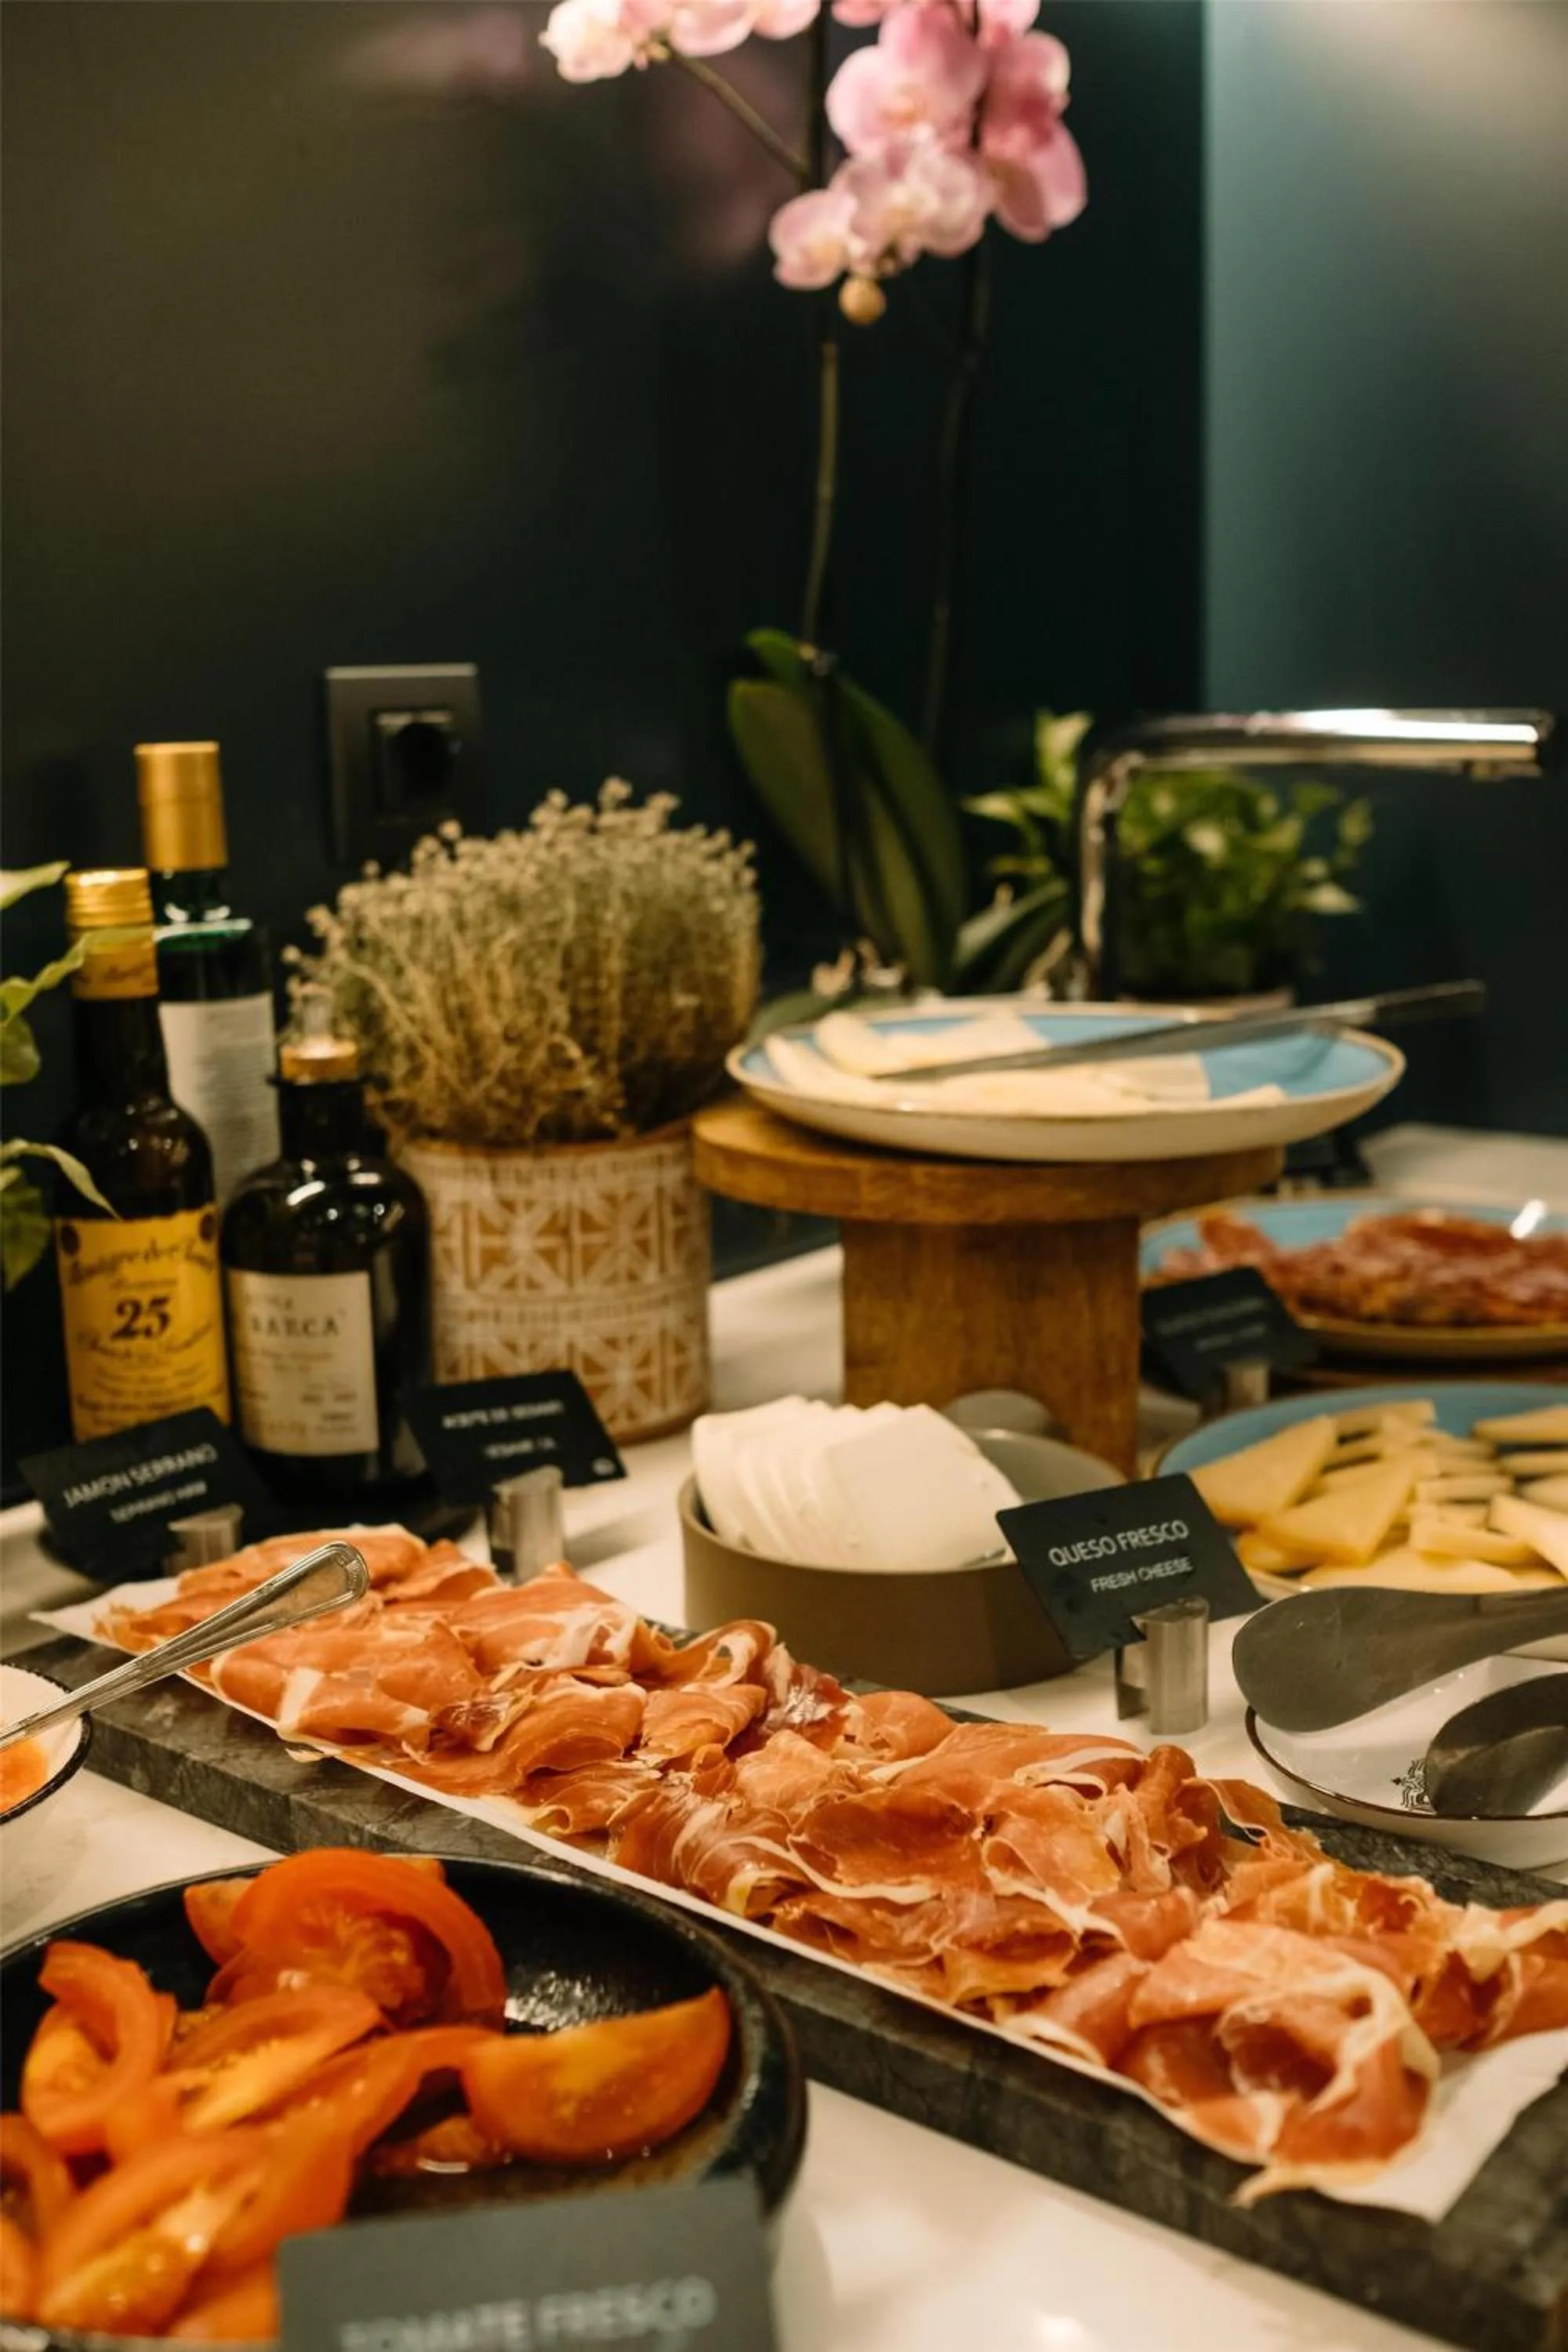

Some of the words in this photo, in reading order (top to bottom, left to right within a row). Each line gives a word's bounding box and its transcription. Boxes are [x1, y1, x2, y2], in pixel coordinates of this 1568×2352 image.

[111, 1295, 170, 1340] 25
[128, 1443, 218, 1486] SERRANO
[1049, 1536, 1117, 1566] QUESO
[1116, 1519, 1189, 1551] FRESCO
[1091, 1570, 1137, 1592] FRESH
[1138, 1557, 1193, 1581] CHEESE
[536, 2275, 717, 2346] FRESCO
